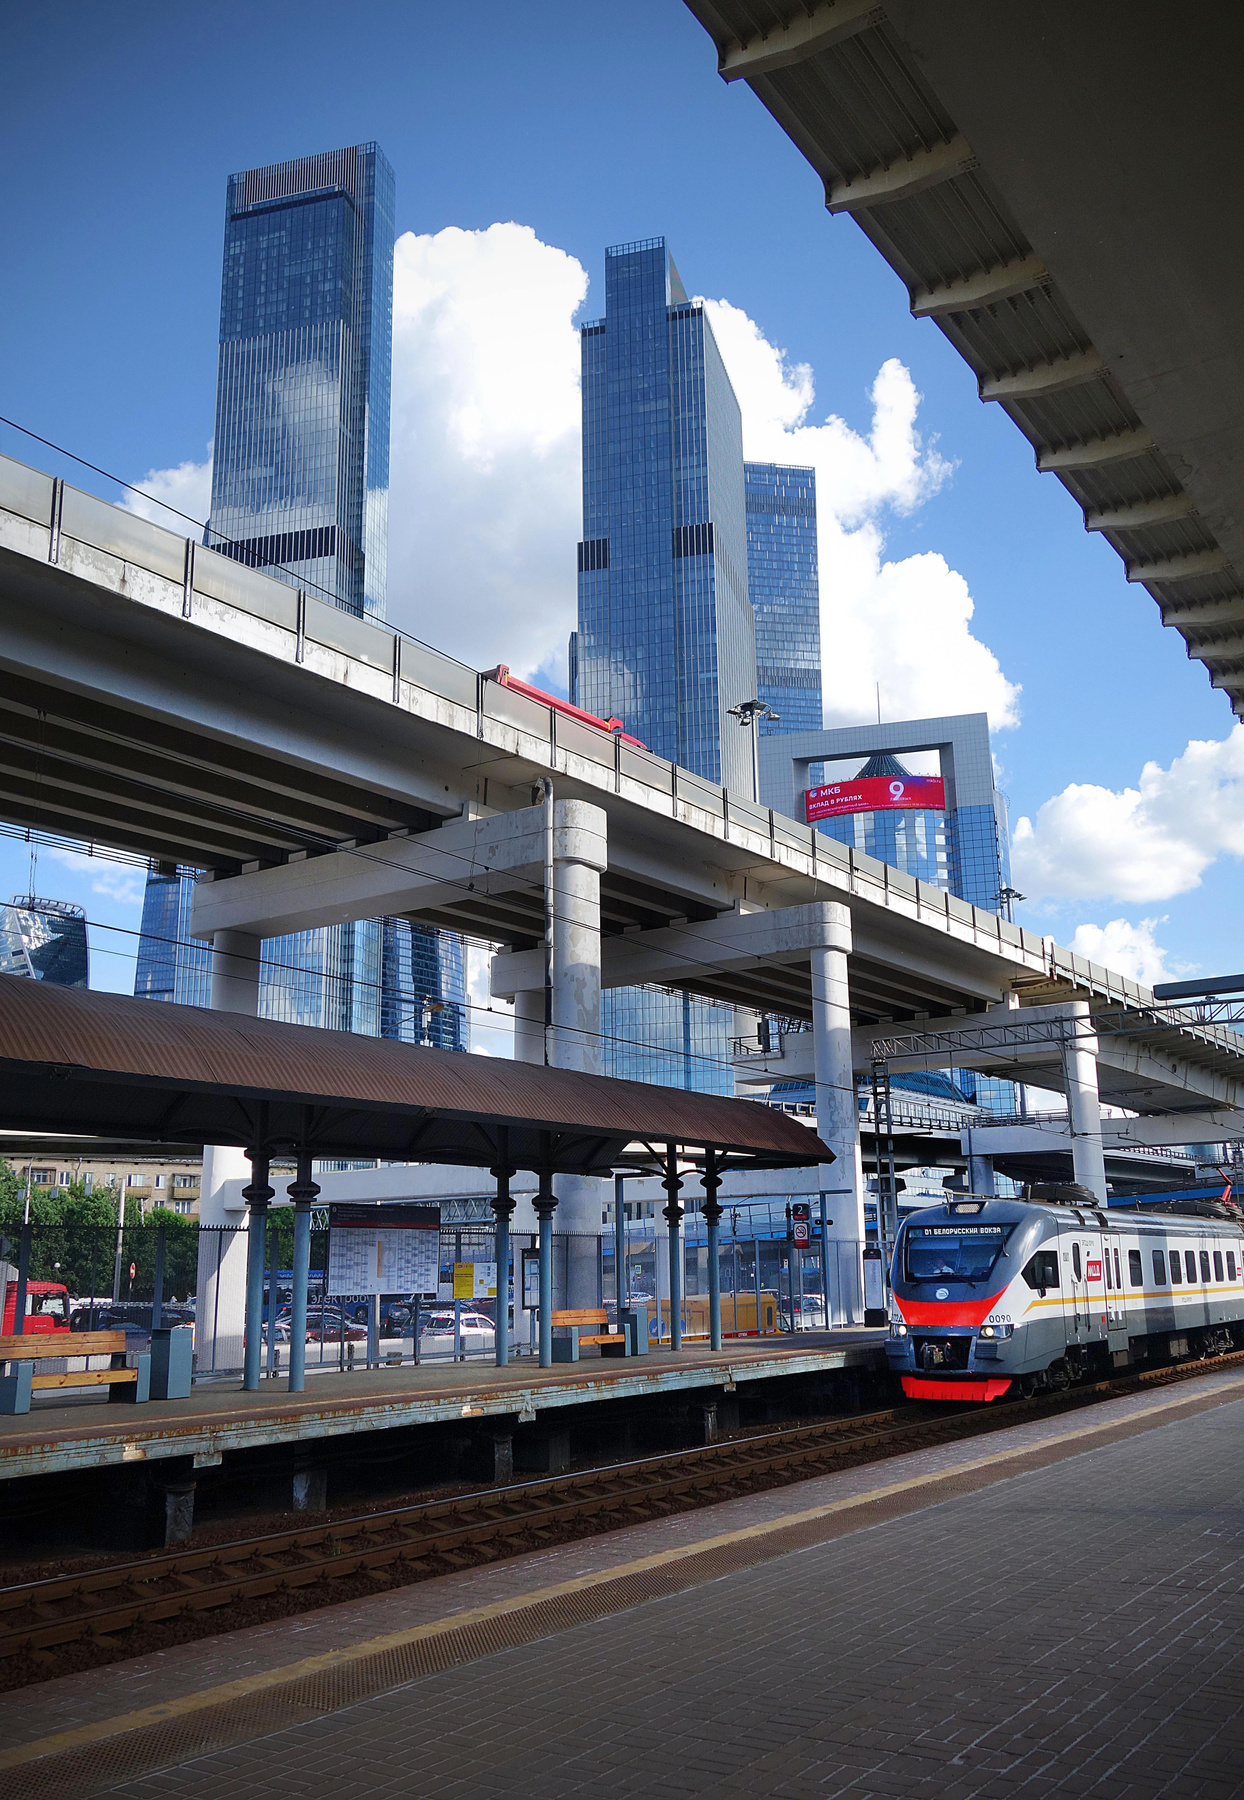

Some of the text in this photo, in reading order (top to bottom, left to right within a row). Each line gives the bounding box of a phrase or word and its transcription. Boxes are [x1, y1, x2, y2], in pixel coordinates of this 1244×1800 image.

[820, 786, 841, 797] МКБ
[889, 781, 904, 801] 9
[808, 800, 830, 810] ВКЛАД
[836, 794, 863, 804] РУБЛЯХ
[797, 1205, 803, 1214] 2
[989, 1314, 1012, 1323] 0090
